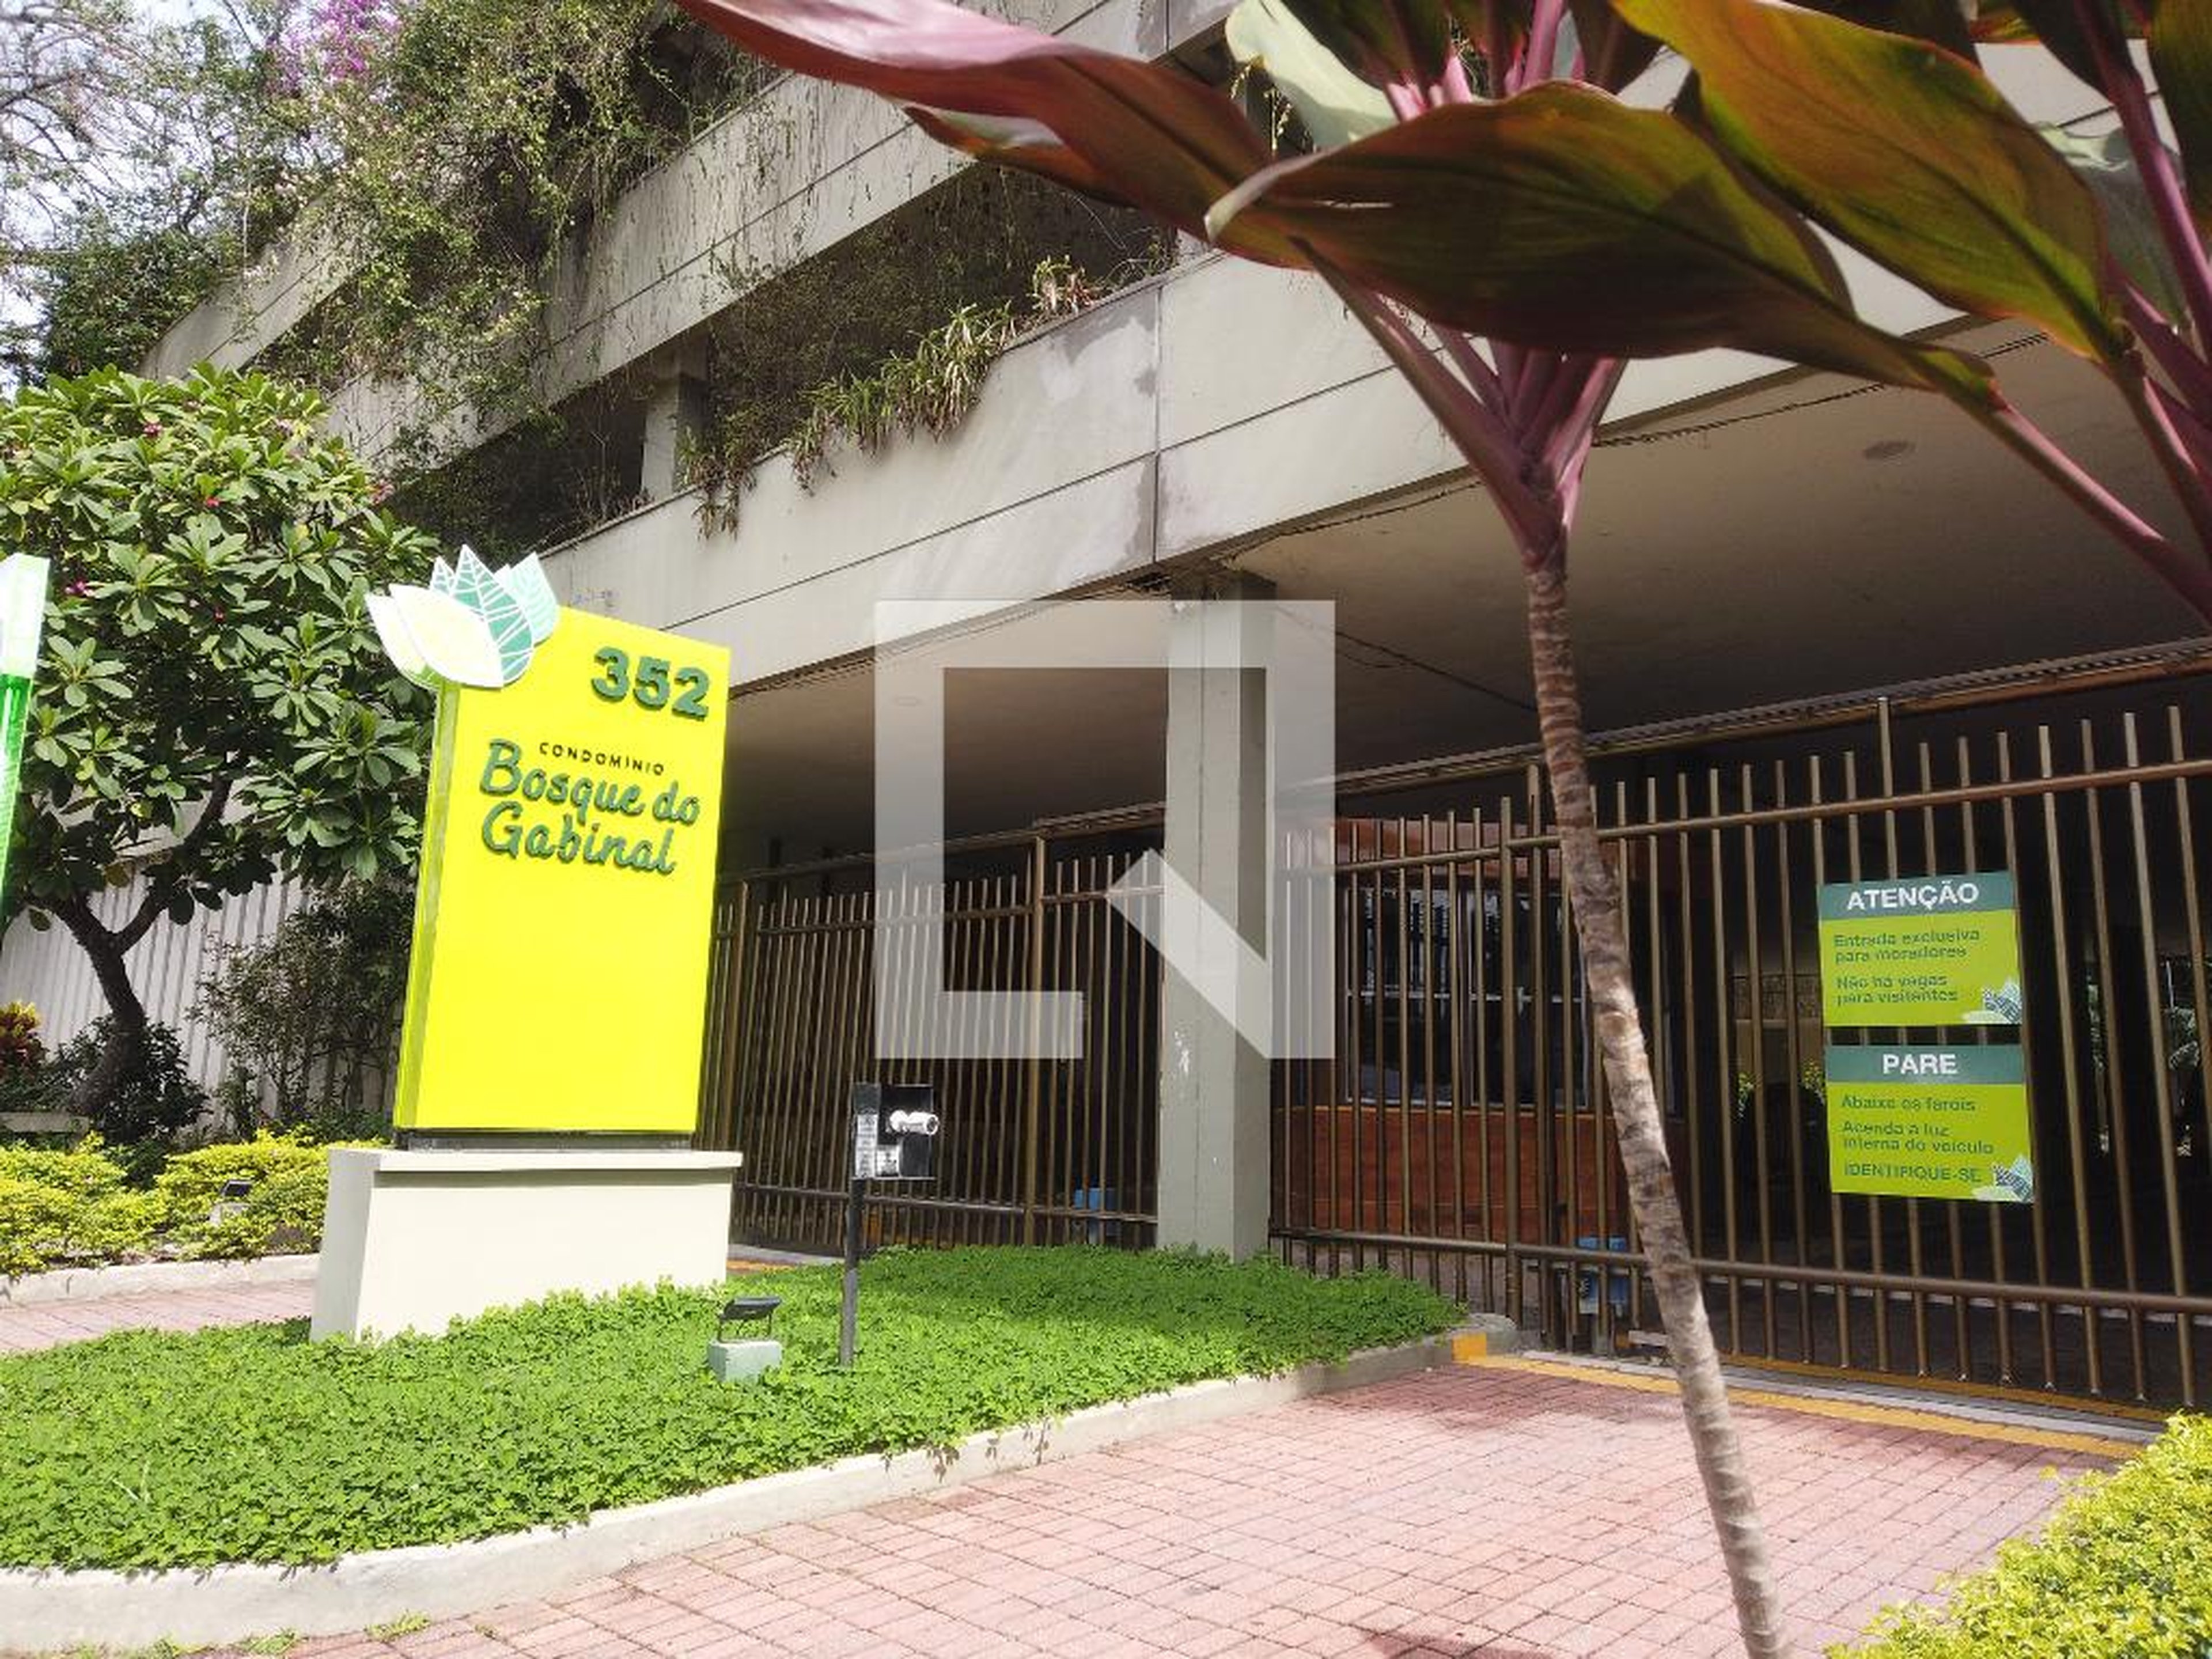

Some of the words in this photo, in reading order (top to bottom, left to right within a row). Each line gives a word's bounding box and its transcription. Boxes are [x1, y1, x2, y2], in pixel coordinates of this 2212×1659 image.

[590, 646, 710, 721] 352
[479, 738, 646, 825] Bosque
[653, 781, 700, 826] do
[482, 801, 676, 875] Gabinal
[1846, 880, 1979, 910] ATENÇÃO
[1834, 932, 1896, 948] Entrada
[1902, 929, 1980, 944] exclusiva
[1835, 952, 1869, 964] para
[1876, 946, 1967, 960] moradores
[1883, 1054, 1959, 1075] PARE
[1902, 1100, 1921, 1111] os
[1843, 1120, 1904, 1135] Acenda
[1908, 1124, 1919, 1135] a
[1925, 1122, 1949, 1137] luz
[1905, 1138, 1926, 1151] do
[1844, 1163, 1982, 1183] IDENTIFIQUE-SE
